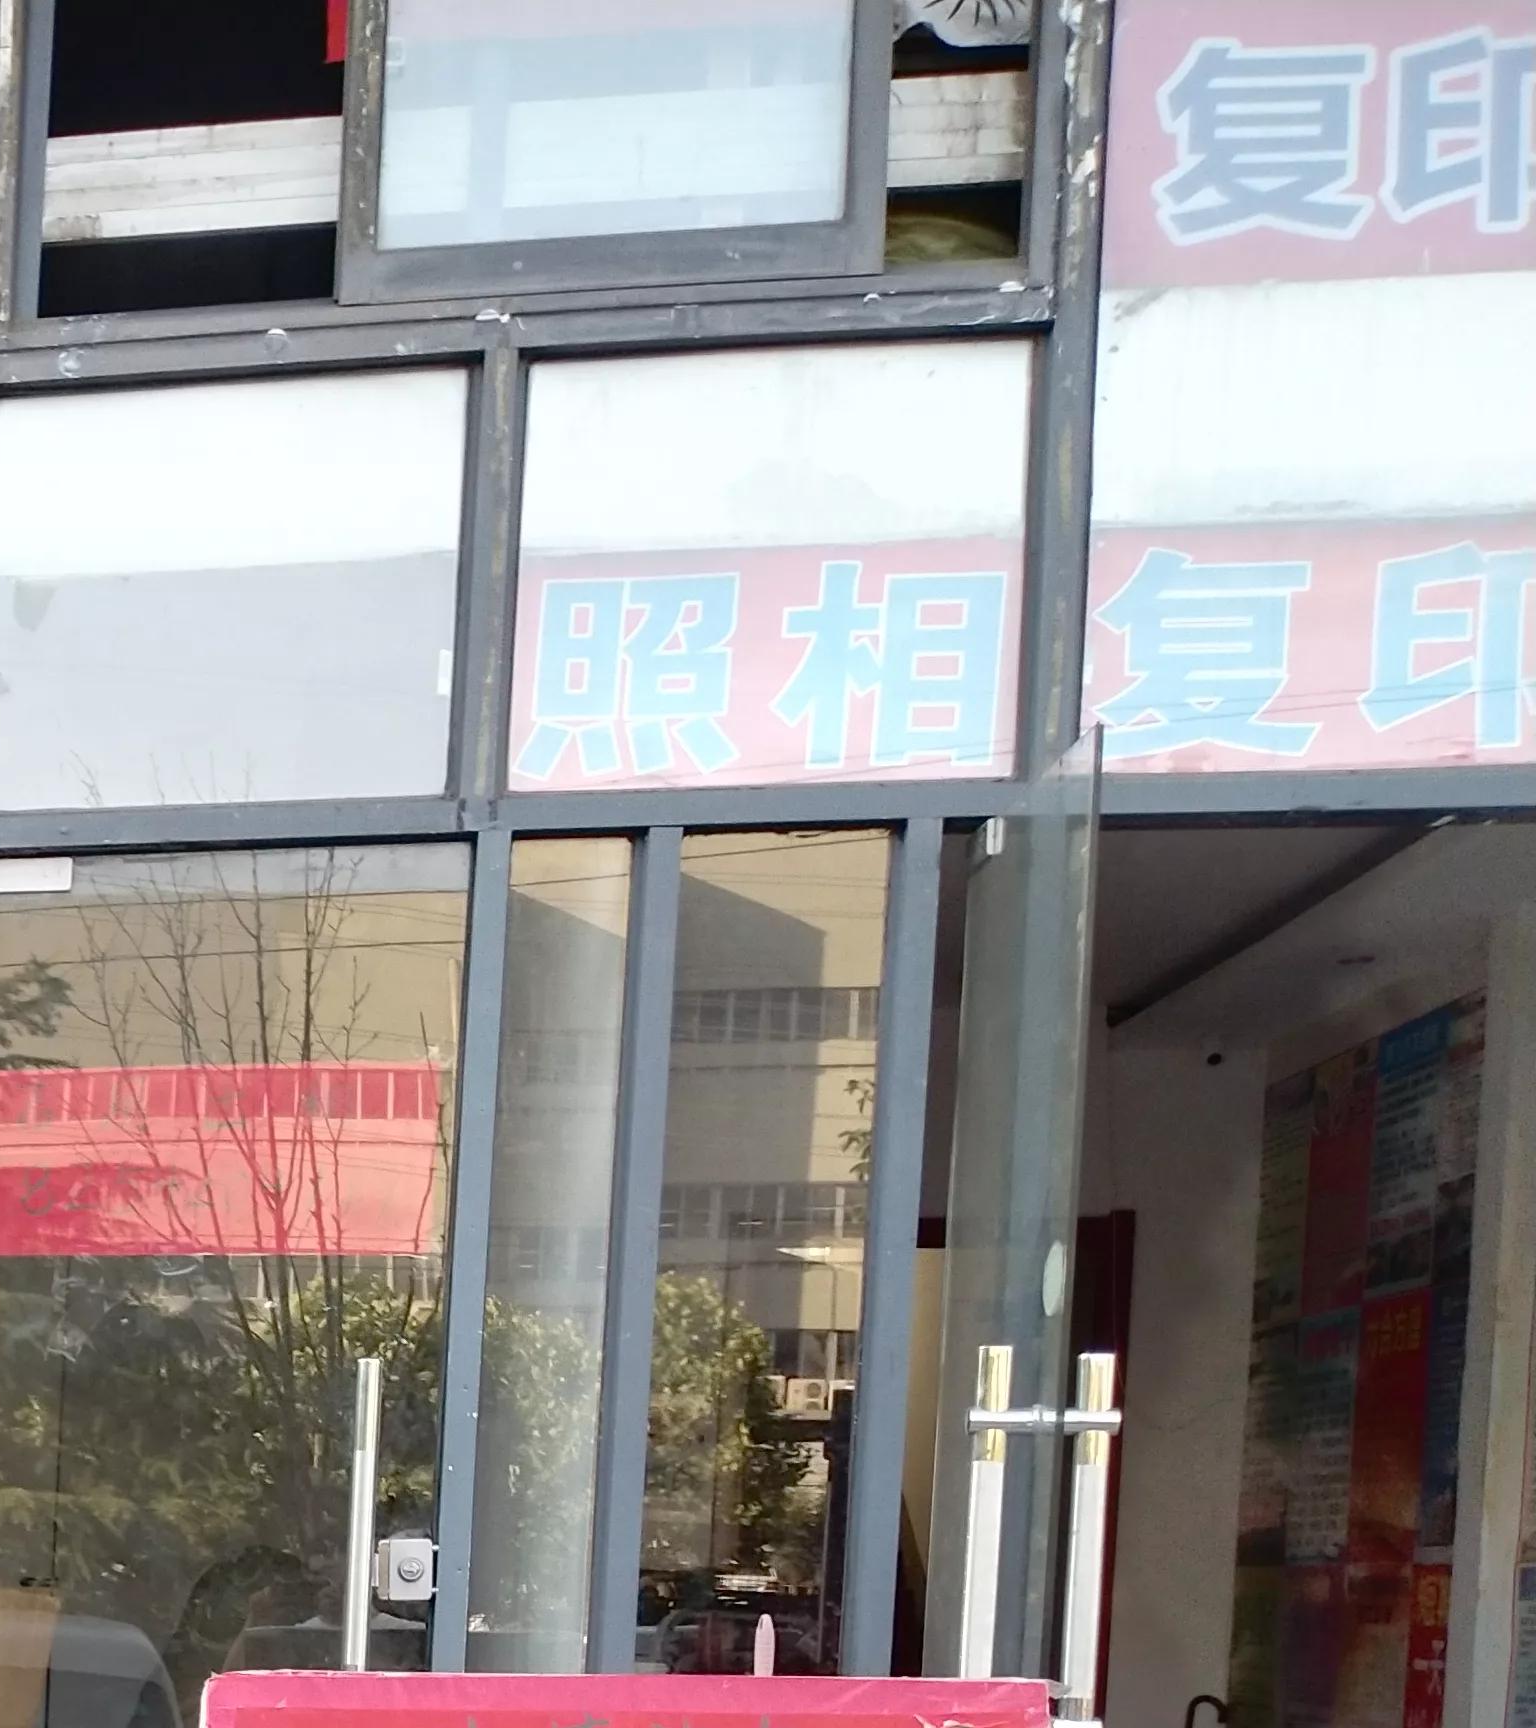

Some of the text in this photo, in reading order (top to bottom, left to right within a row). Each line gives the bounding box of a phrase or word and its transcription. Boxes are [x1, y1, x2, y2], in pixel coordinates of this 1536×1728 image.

[1154, 28, 1536, 246] 复印
[512, 542, 1536, 782] 照相 复印
